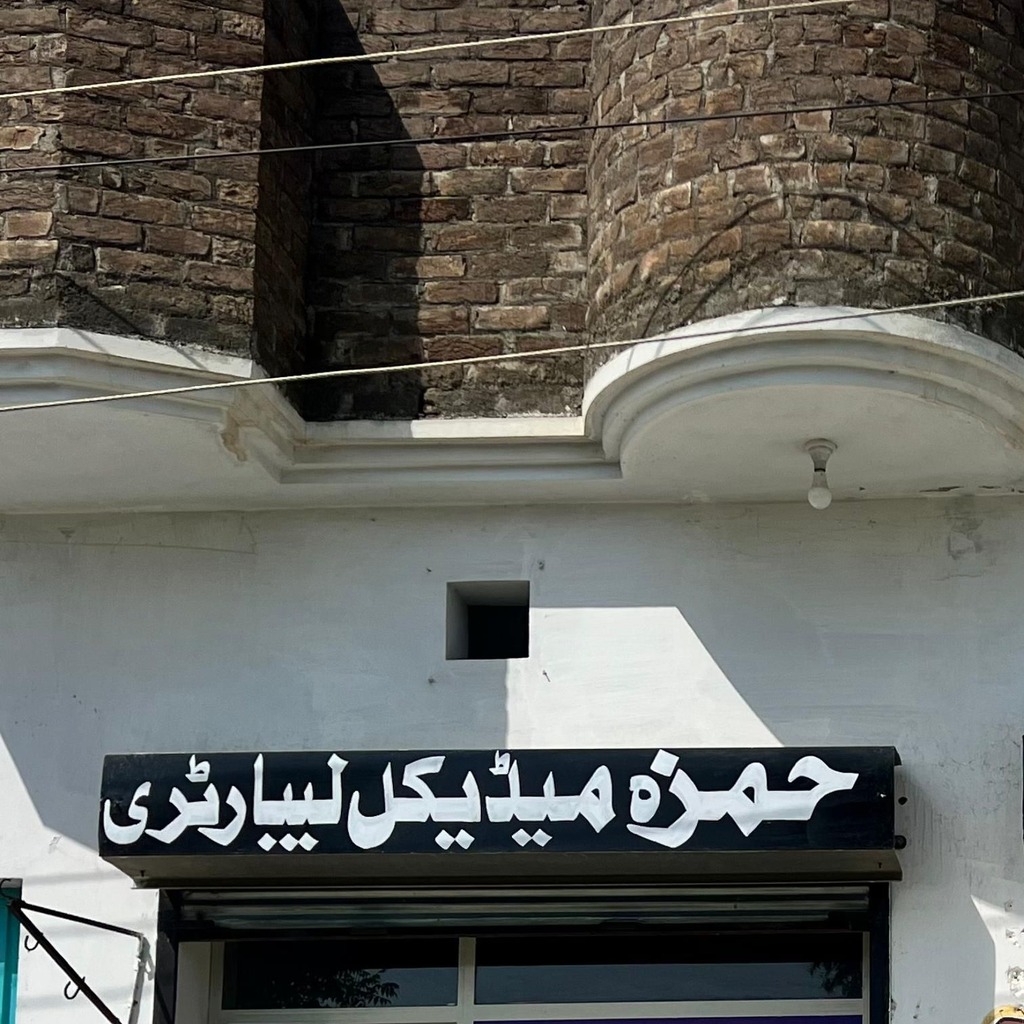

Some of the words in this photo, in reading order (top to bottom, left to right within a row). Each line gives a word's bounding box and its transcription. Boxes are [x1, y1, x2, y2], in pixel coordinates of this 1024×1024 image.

[103, 753, 349, 851] لیبارٹری
[347, 750, 617, 850] میڈیکل
[627, 748, 860, 849] حمزہ
